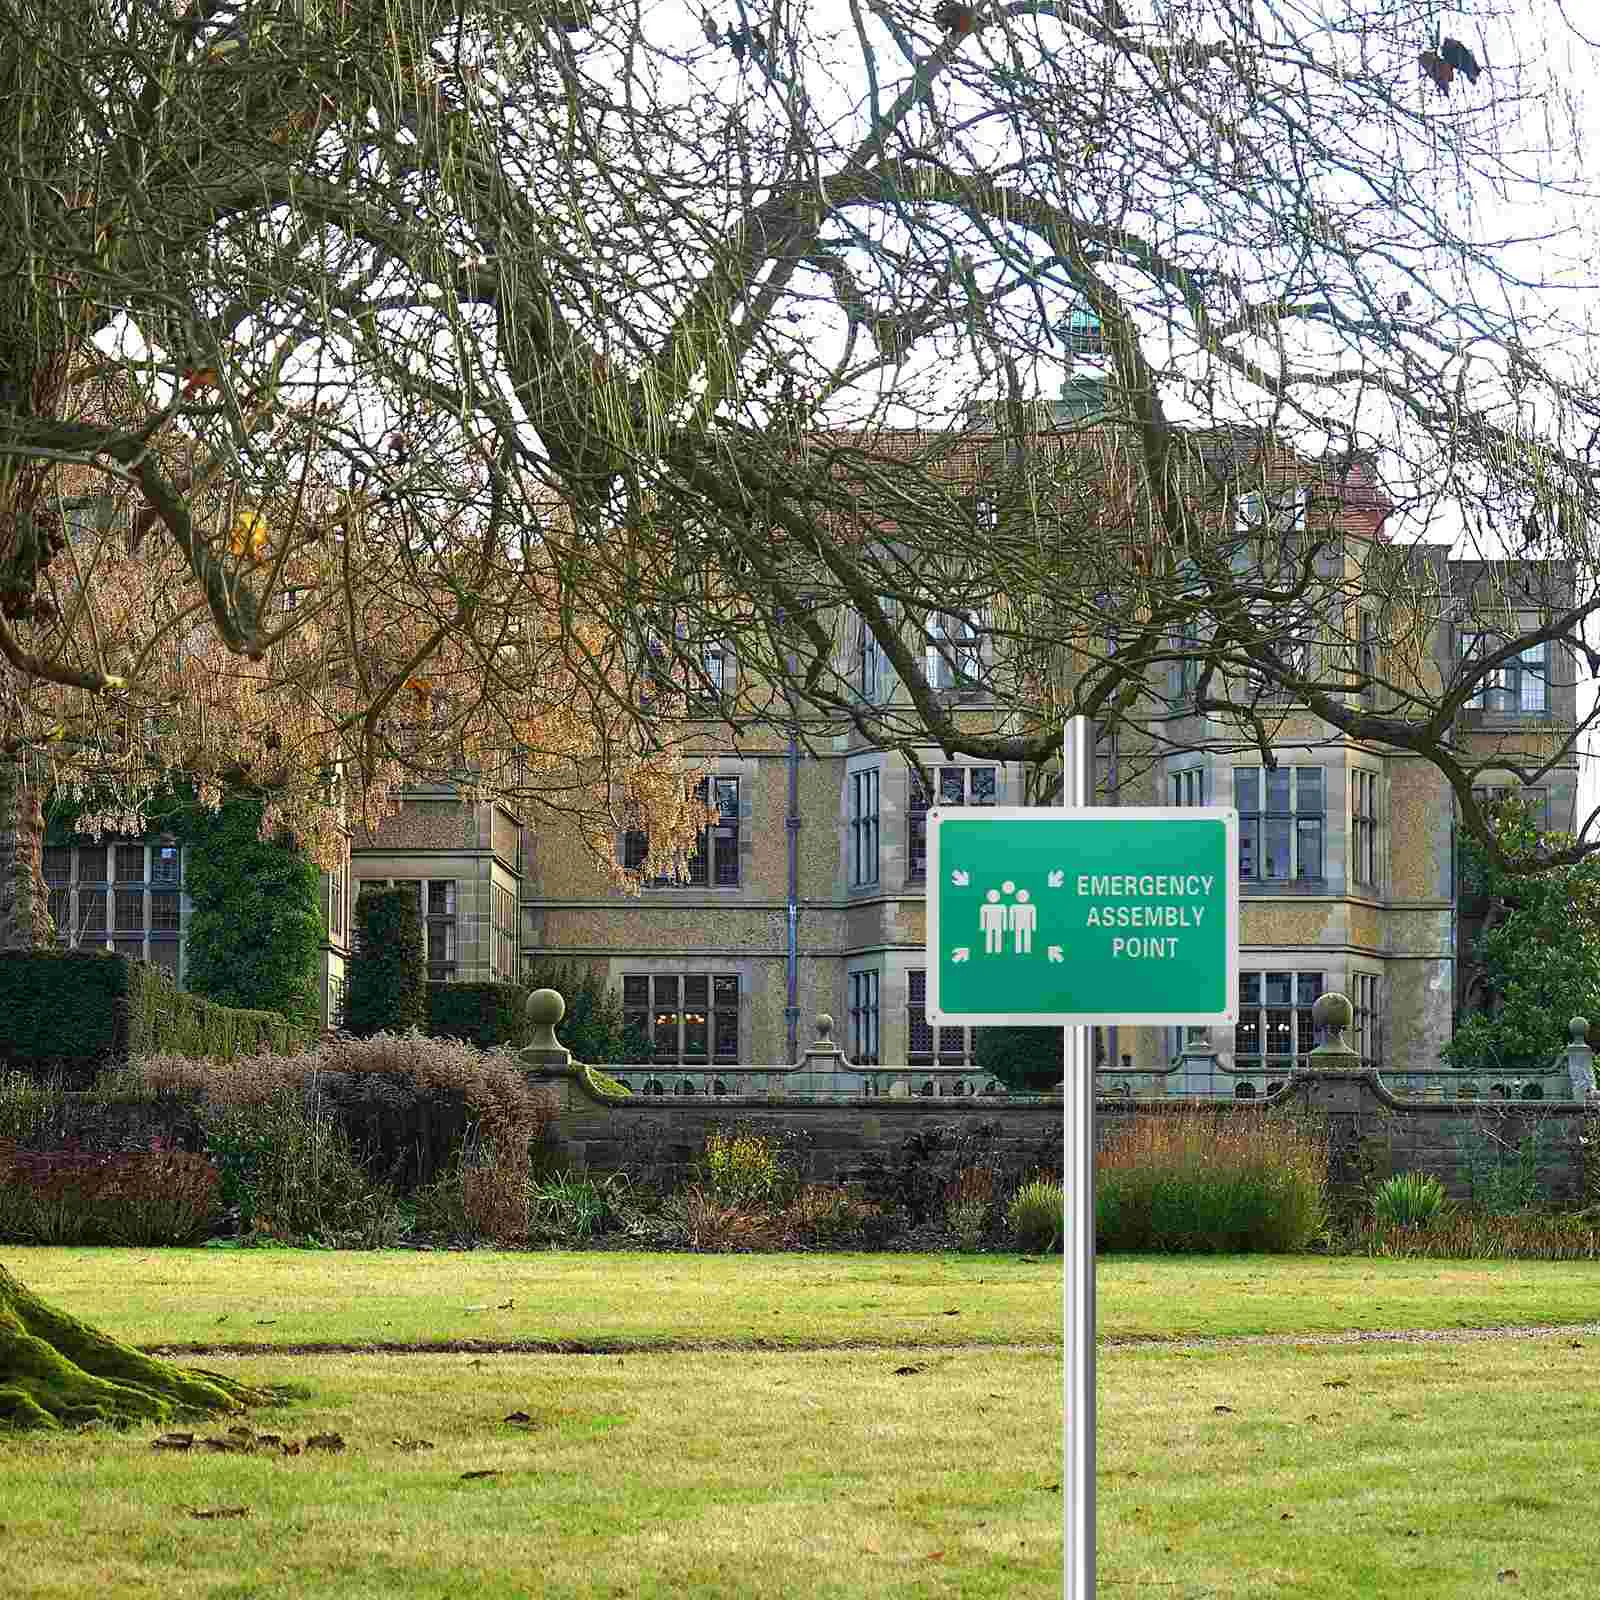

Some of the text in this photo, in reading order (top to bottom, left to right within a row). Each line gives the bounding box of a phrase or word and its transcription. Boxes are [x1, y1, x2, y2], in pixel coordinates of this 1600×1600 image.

[1077, 875, 1214, 896] EMERGENCY
[1086, 906, 1205, 927] ASSEMBLY
[1112, 937, 1179, 958] POINT
